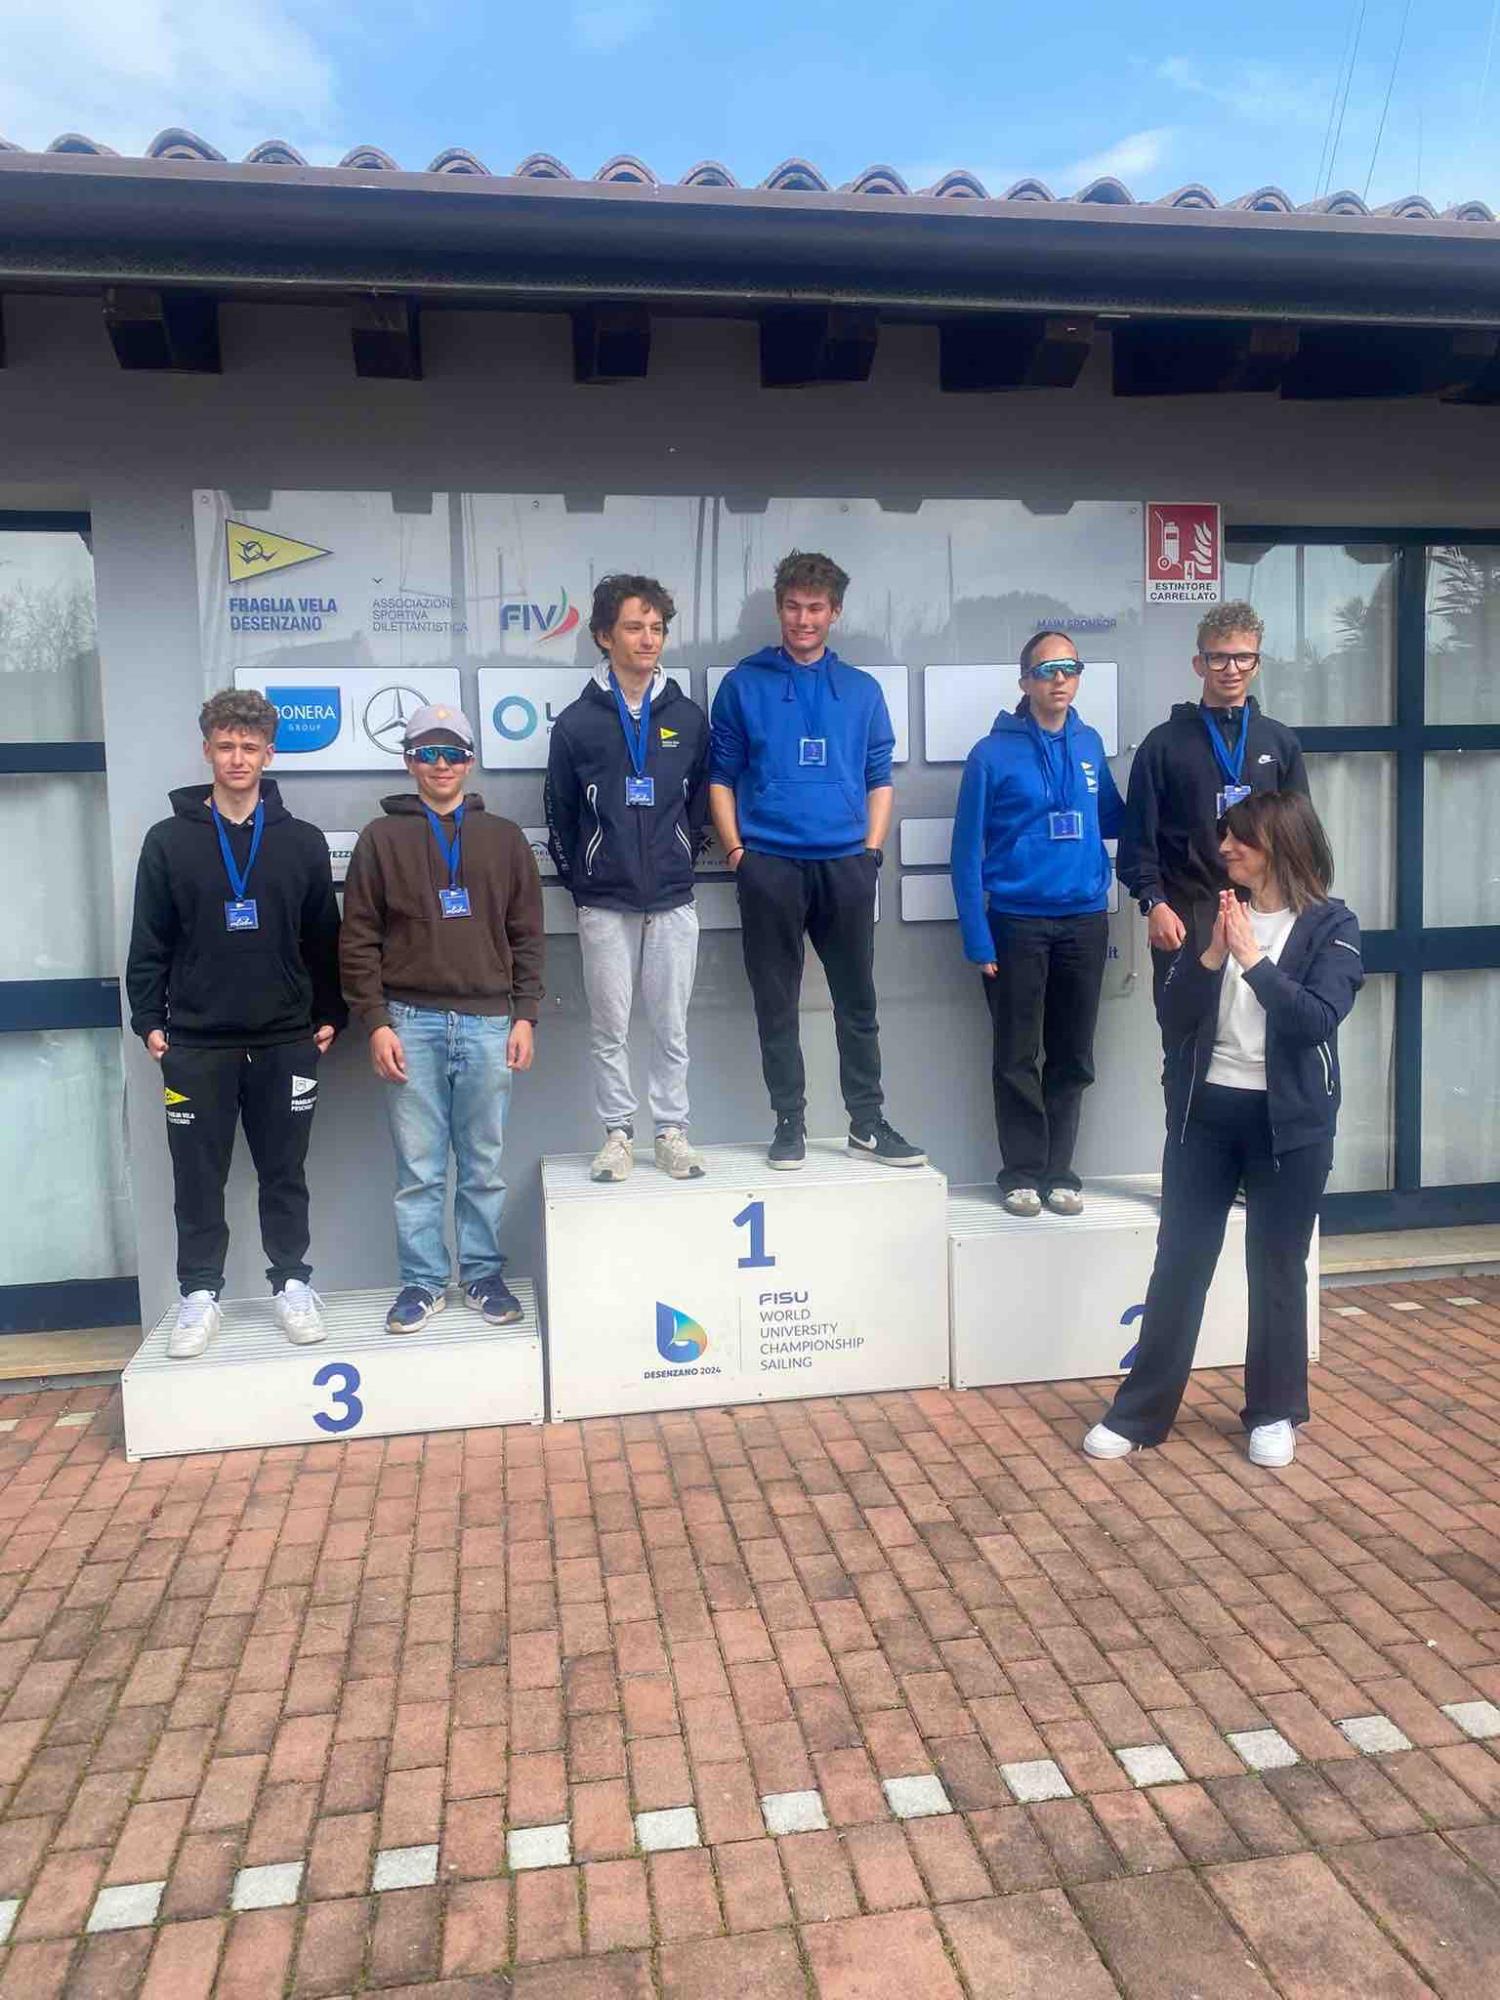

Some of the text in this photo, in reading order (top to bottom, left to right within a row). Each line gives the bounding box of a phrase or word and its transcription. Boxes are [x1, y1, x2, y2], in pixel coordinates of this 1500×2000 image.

[1155, 582, 1212, 591] ESTINTORE
[1150, 592, 1217, 601] CARRELLATO
[229, 598, 337, 613] FRAGLIA VELA
[372, 599, 458, 609] ASSOCIAZIONE
[372, 610, 428, 620] SPORTIVA
[500, 604, 558, 631] FIV
[230, 616, 322, 631] DESENZANO
[372, 621, 469, 632] DILETTANTISTICA
[1036, 617, 1117, 628] MAIN SPONSOR
[288, 723, 321, 732] GROUP
[732, 1201, 776, 1268] 1
[759, 1291, 809, 1305] FISU
[760, 1308, 811, 1322] WORLD
[760, 1322, 838, 1338] UNIVERSITY
[760, 1337, 864, 1355] CHAMPIONSHIP
[760, 1356, 812, 1371] SAILING
[644, 1366, 721, 1379] DESENZANO 2024
[312, 1362, 363, 1433] 3
